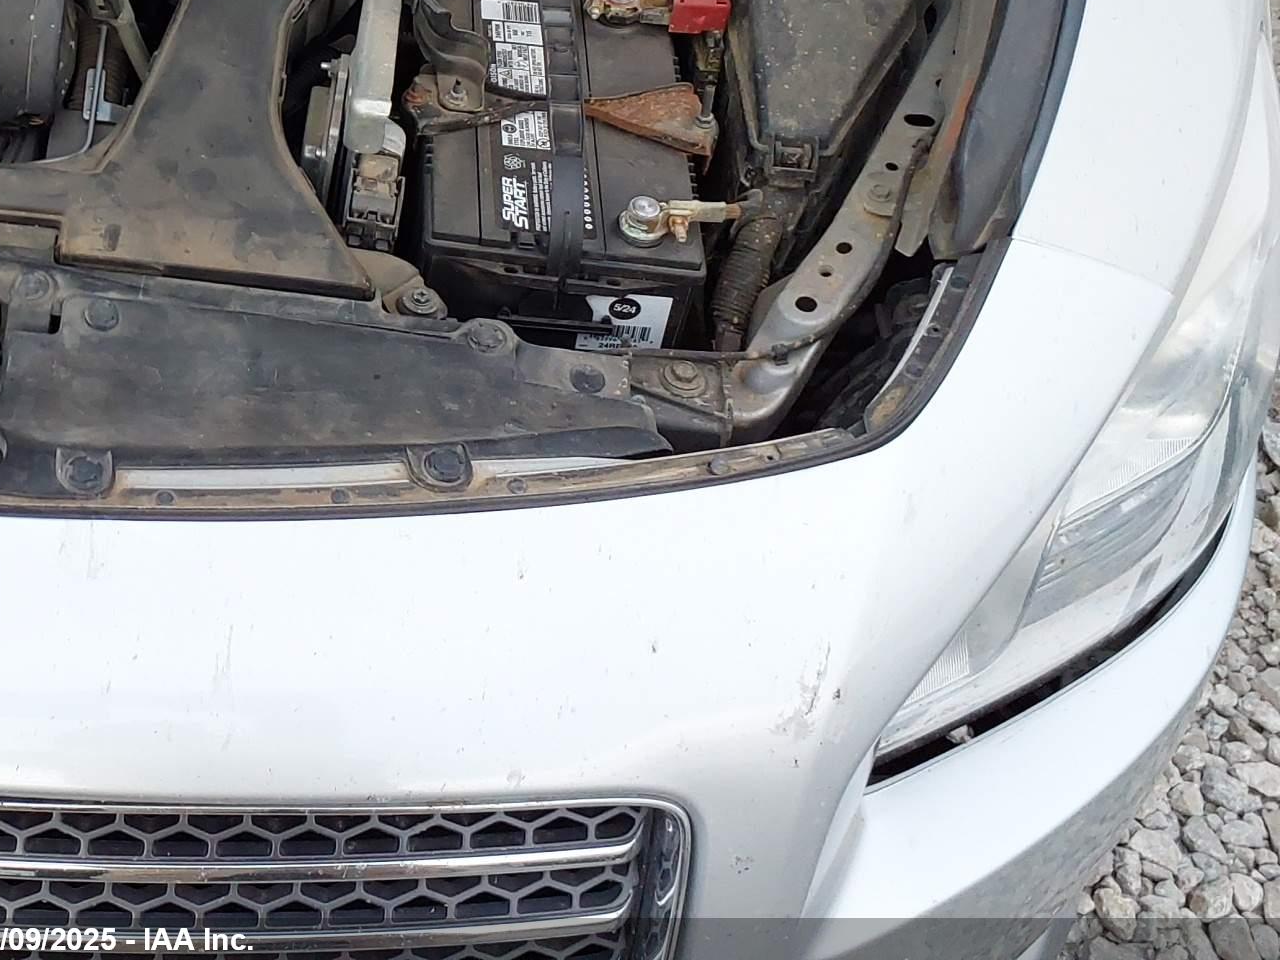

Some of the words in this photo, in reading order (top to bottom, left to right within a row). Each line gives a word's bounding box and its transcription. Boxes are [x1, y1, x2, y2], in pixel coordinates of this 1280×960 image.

[501, 175, 515, 222] SUPER
[512, 177, 529, 230] START
[613, 303, 637, 315] 5/24
